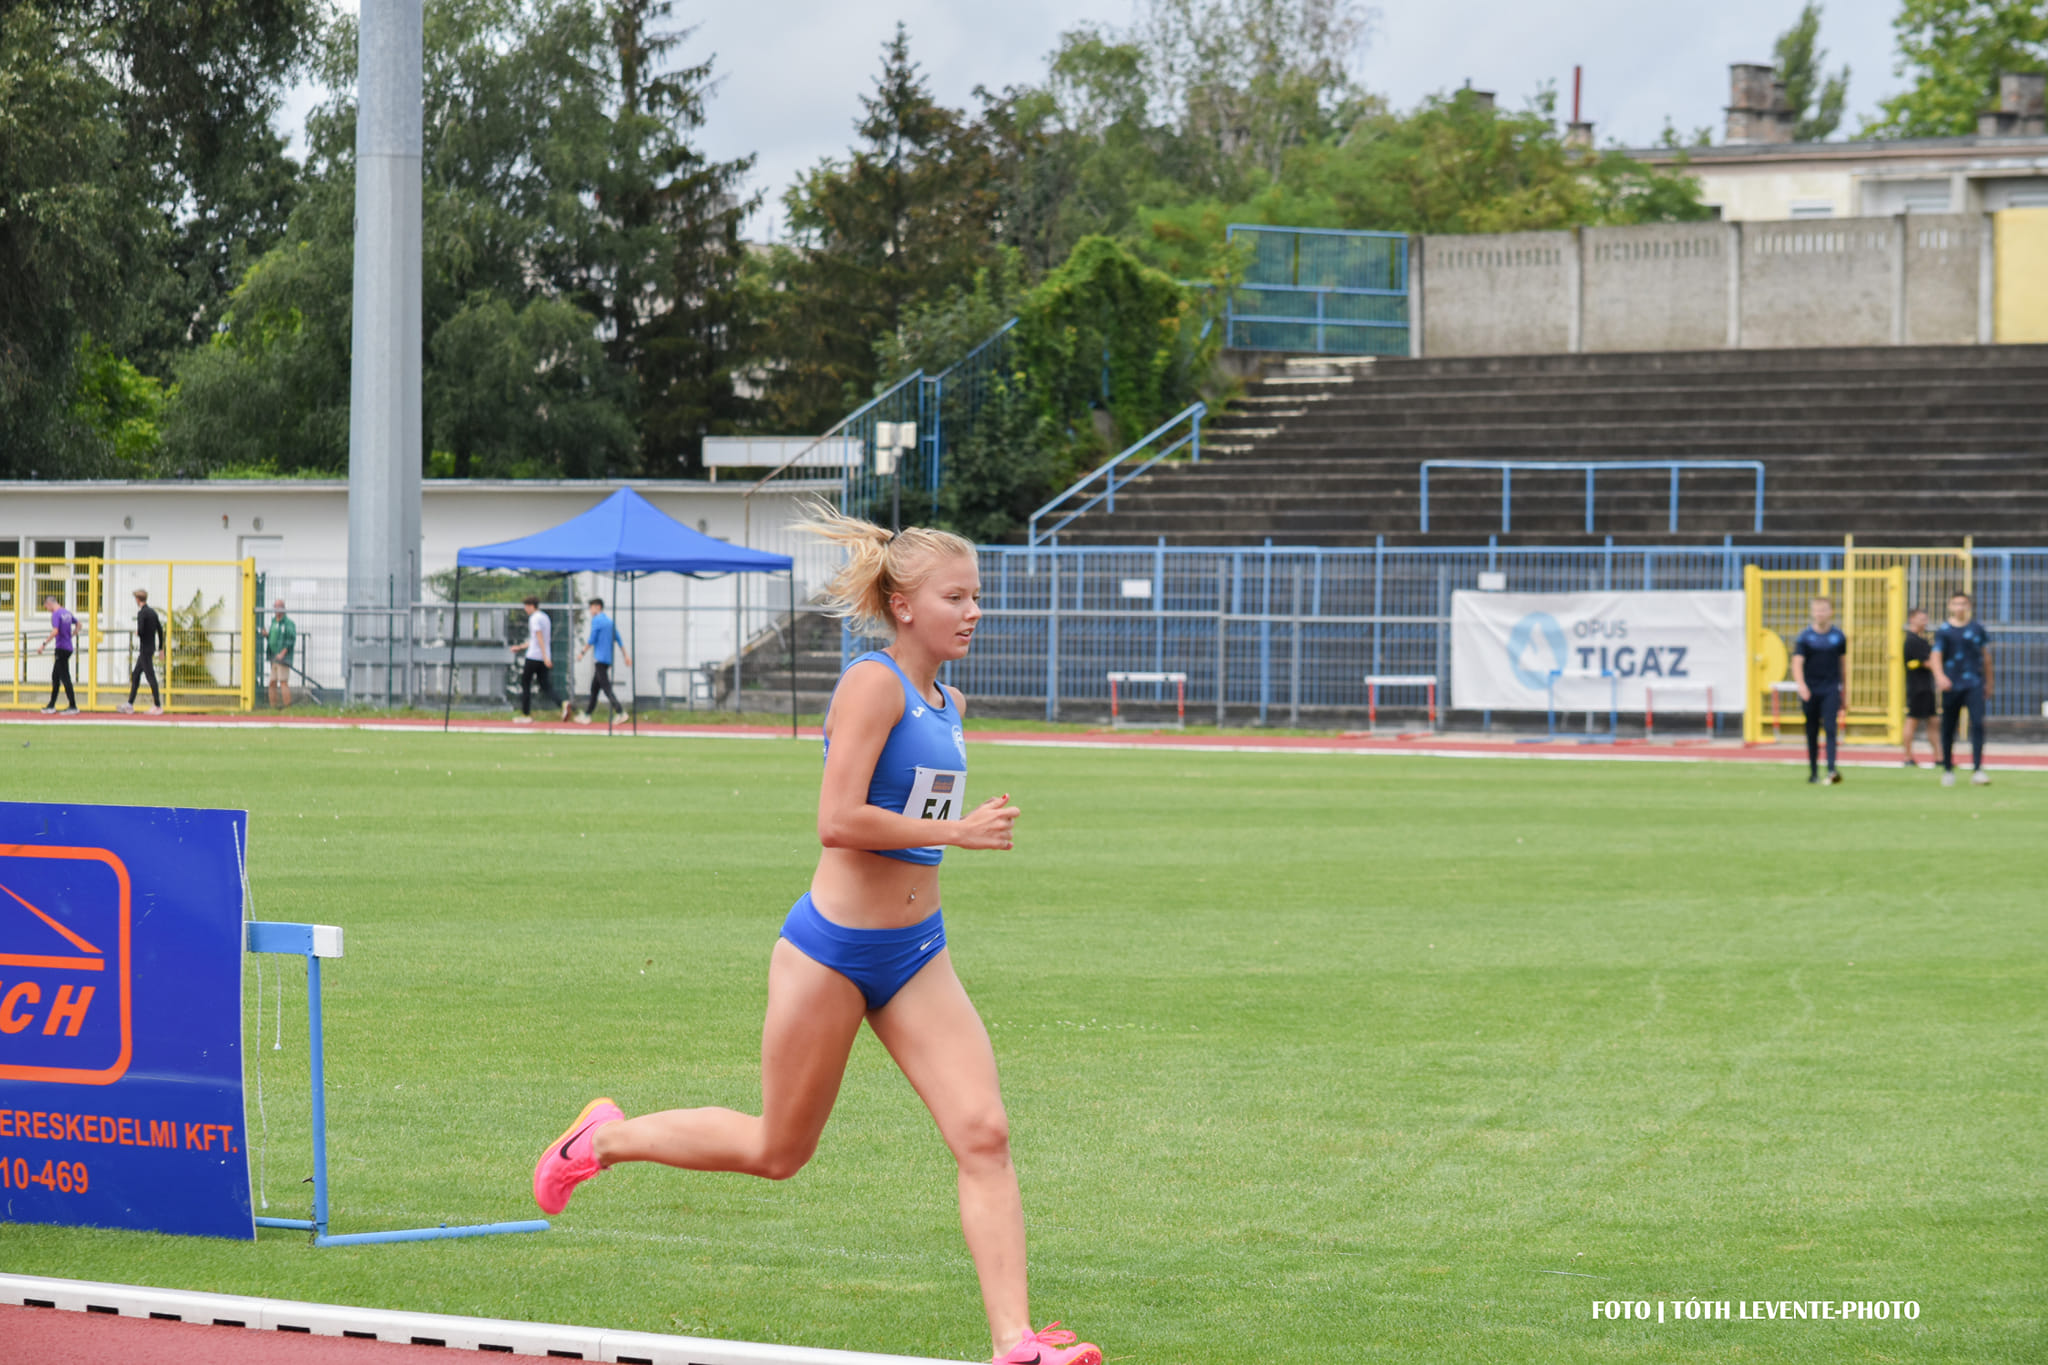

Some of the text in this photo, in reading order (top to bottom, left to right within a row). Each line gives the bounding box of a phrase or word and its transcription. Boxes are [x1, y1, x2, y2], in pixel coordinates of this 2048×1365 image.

[1574, 619, 1627, 639] OPUS
[0, 981, 96, 1036] CH
[185, 1122, 238, 1153] KFT.
